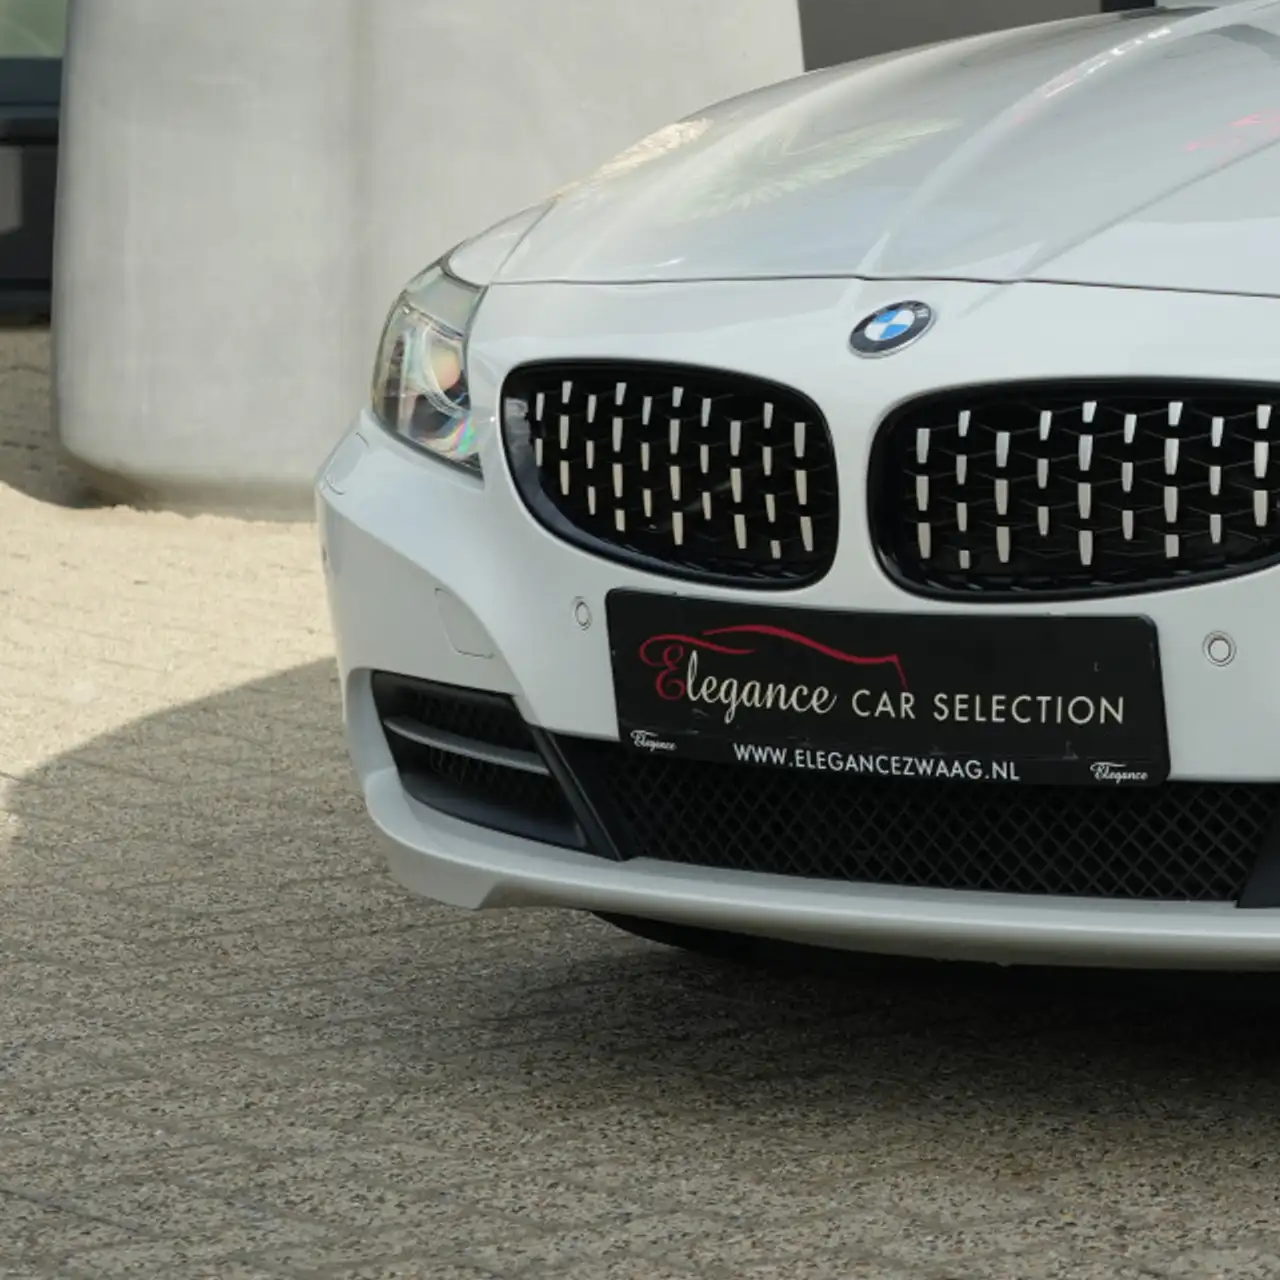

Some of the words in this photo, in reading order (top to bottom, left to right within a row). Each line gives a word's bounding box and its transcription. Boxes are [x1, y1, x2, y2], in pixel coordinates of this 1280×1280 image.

[639, 633, 838, 725] Elegance
[850, 689, 916, 719] CAR
[932, 693, 1125, 725] SELECTION
[732, 742, 1021, 782] WWW.ELEGANCEZWAAG.NL
